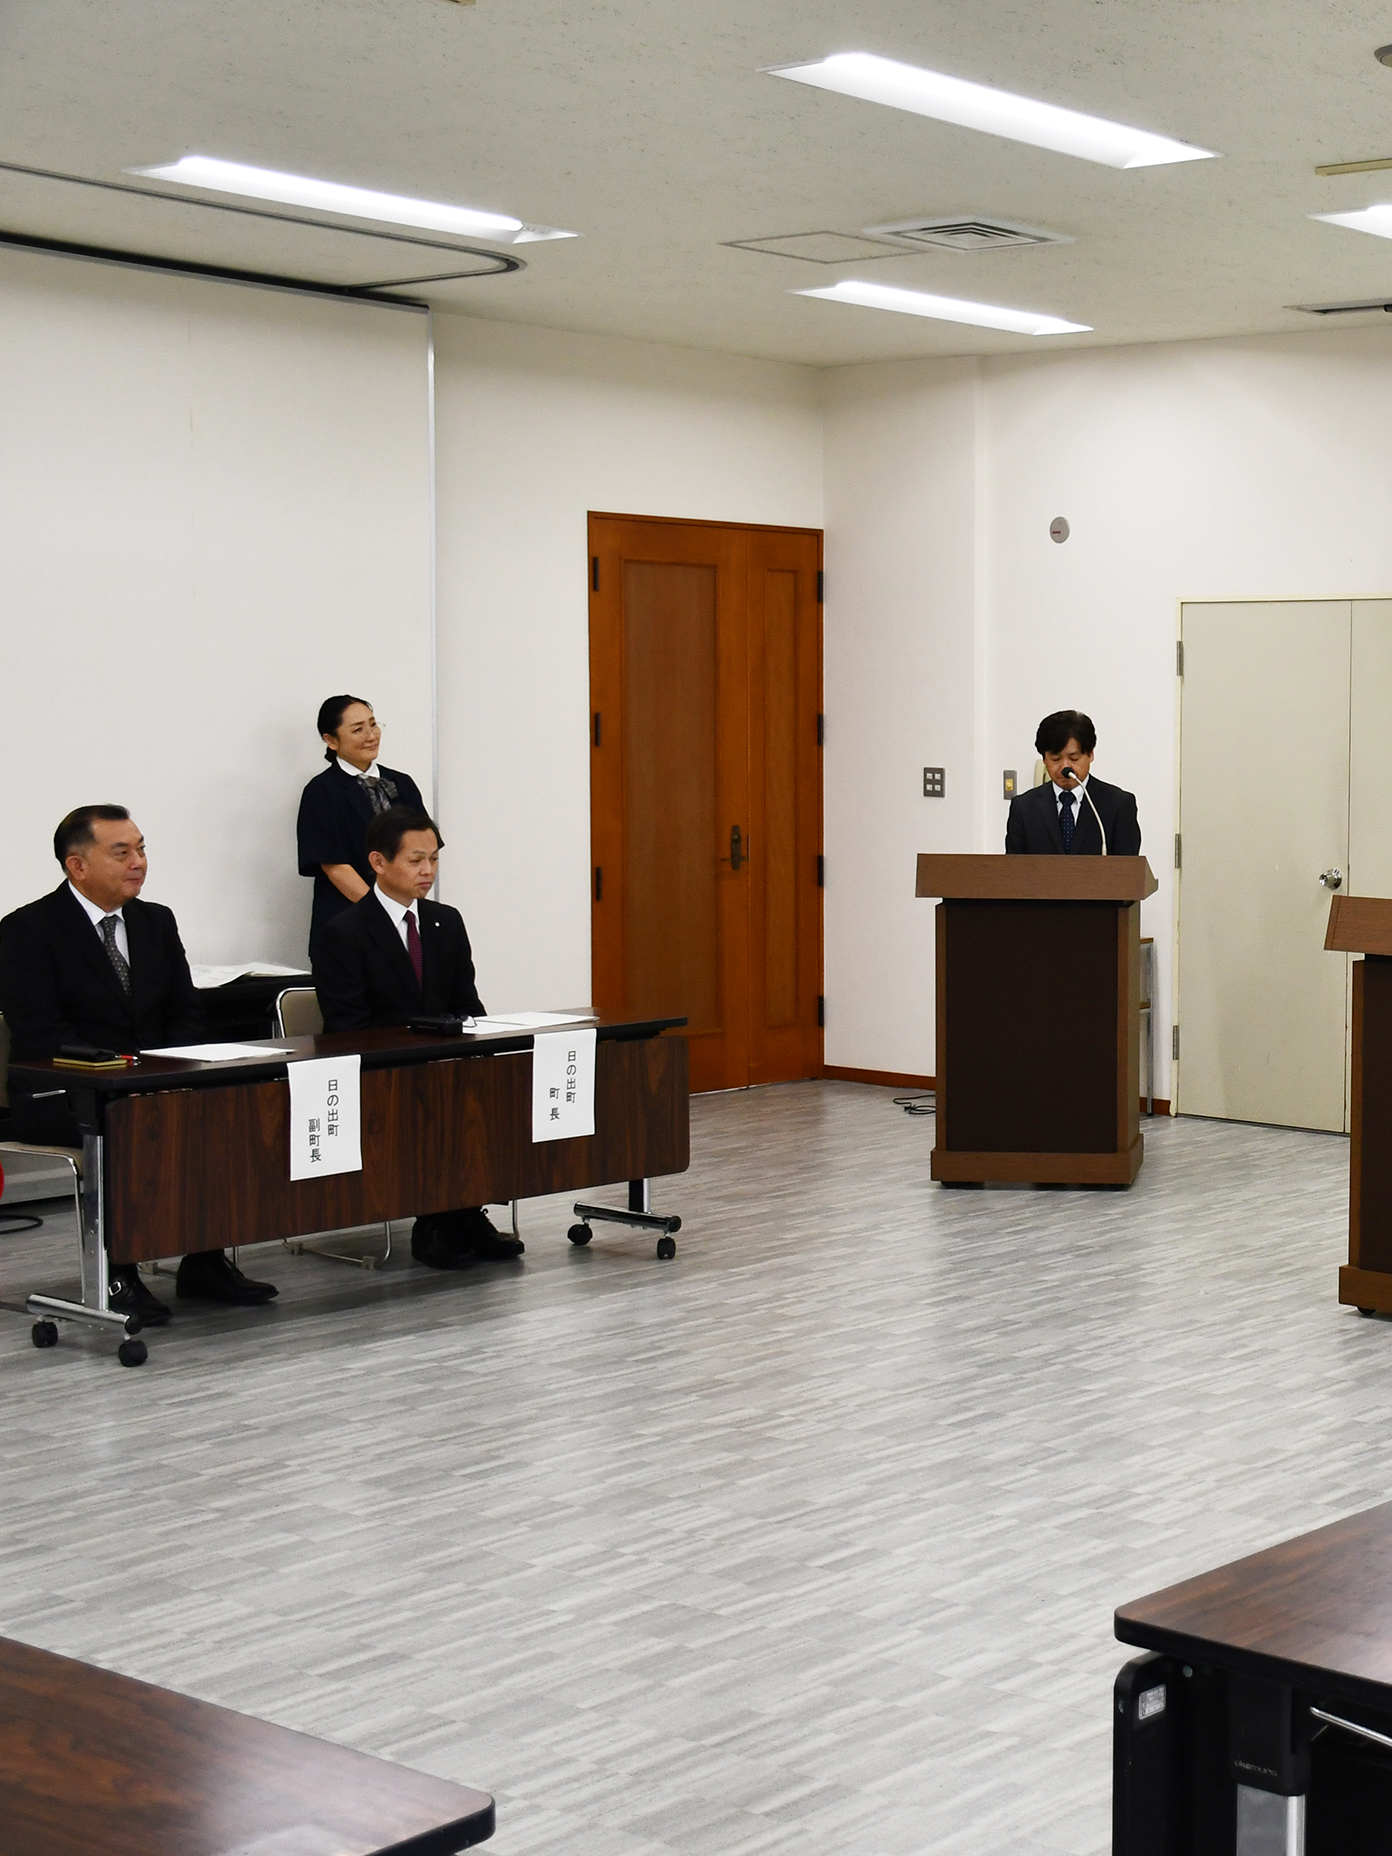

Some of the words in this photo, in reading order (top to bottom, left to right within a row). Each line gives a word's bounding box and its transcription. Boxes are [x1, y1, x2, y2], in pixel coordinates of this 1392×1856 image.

[565, 1050, 577, 1104] 日の出町
[326, 1079, 340, 1137] 日の出町
[308, 1118, 322, 1163] 副町長
